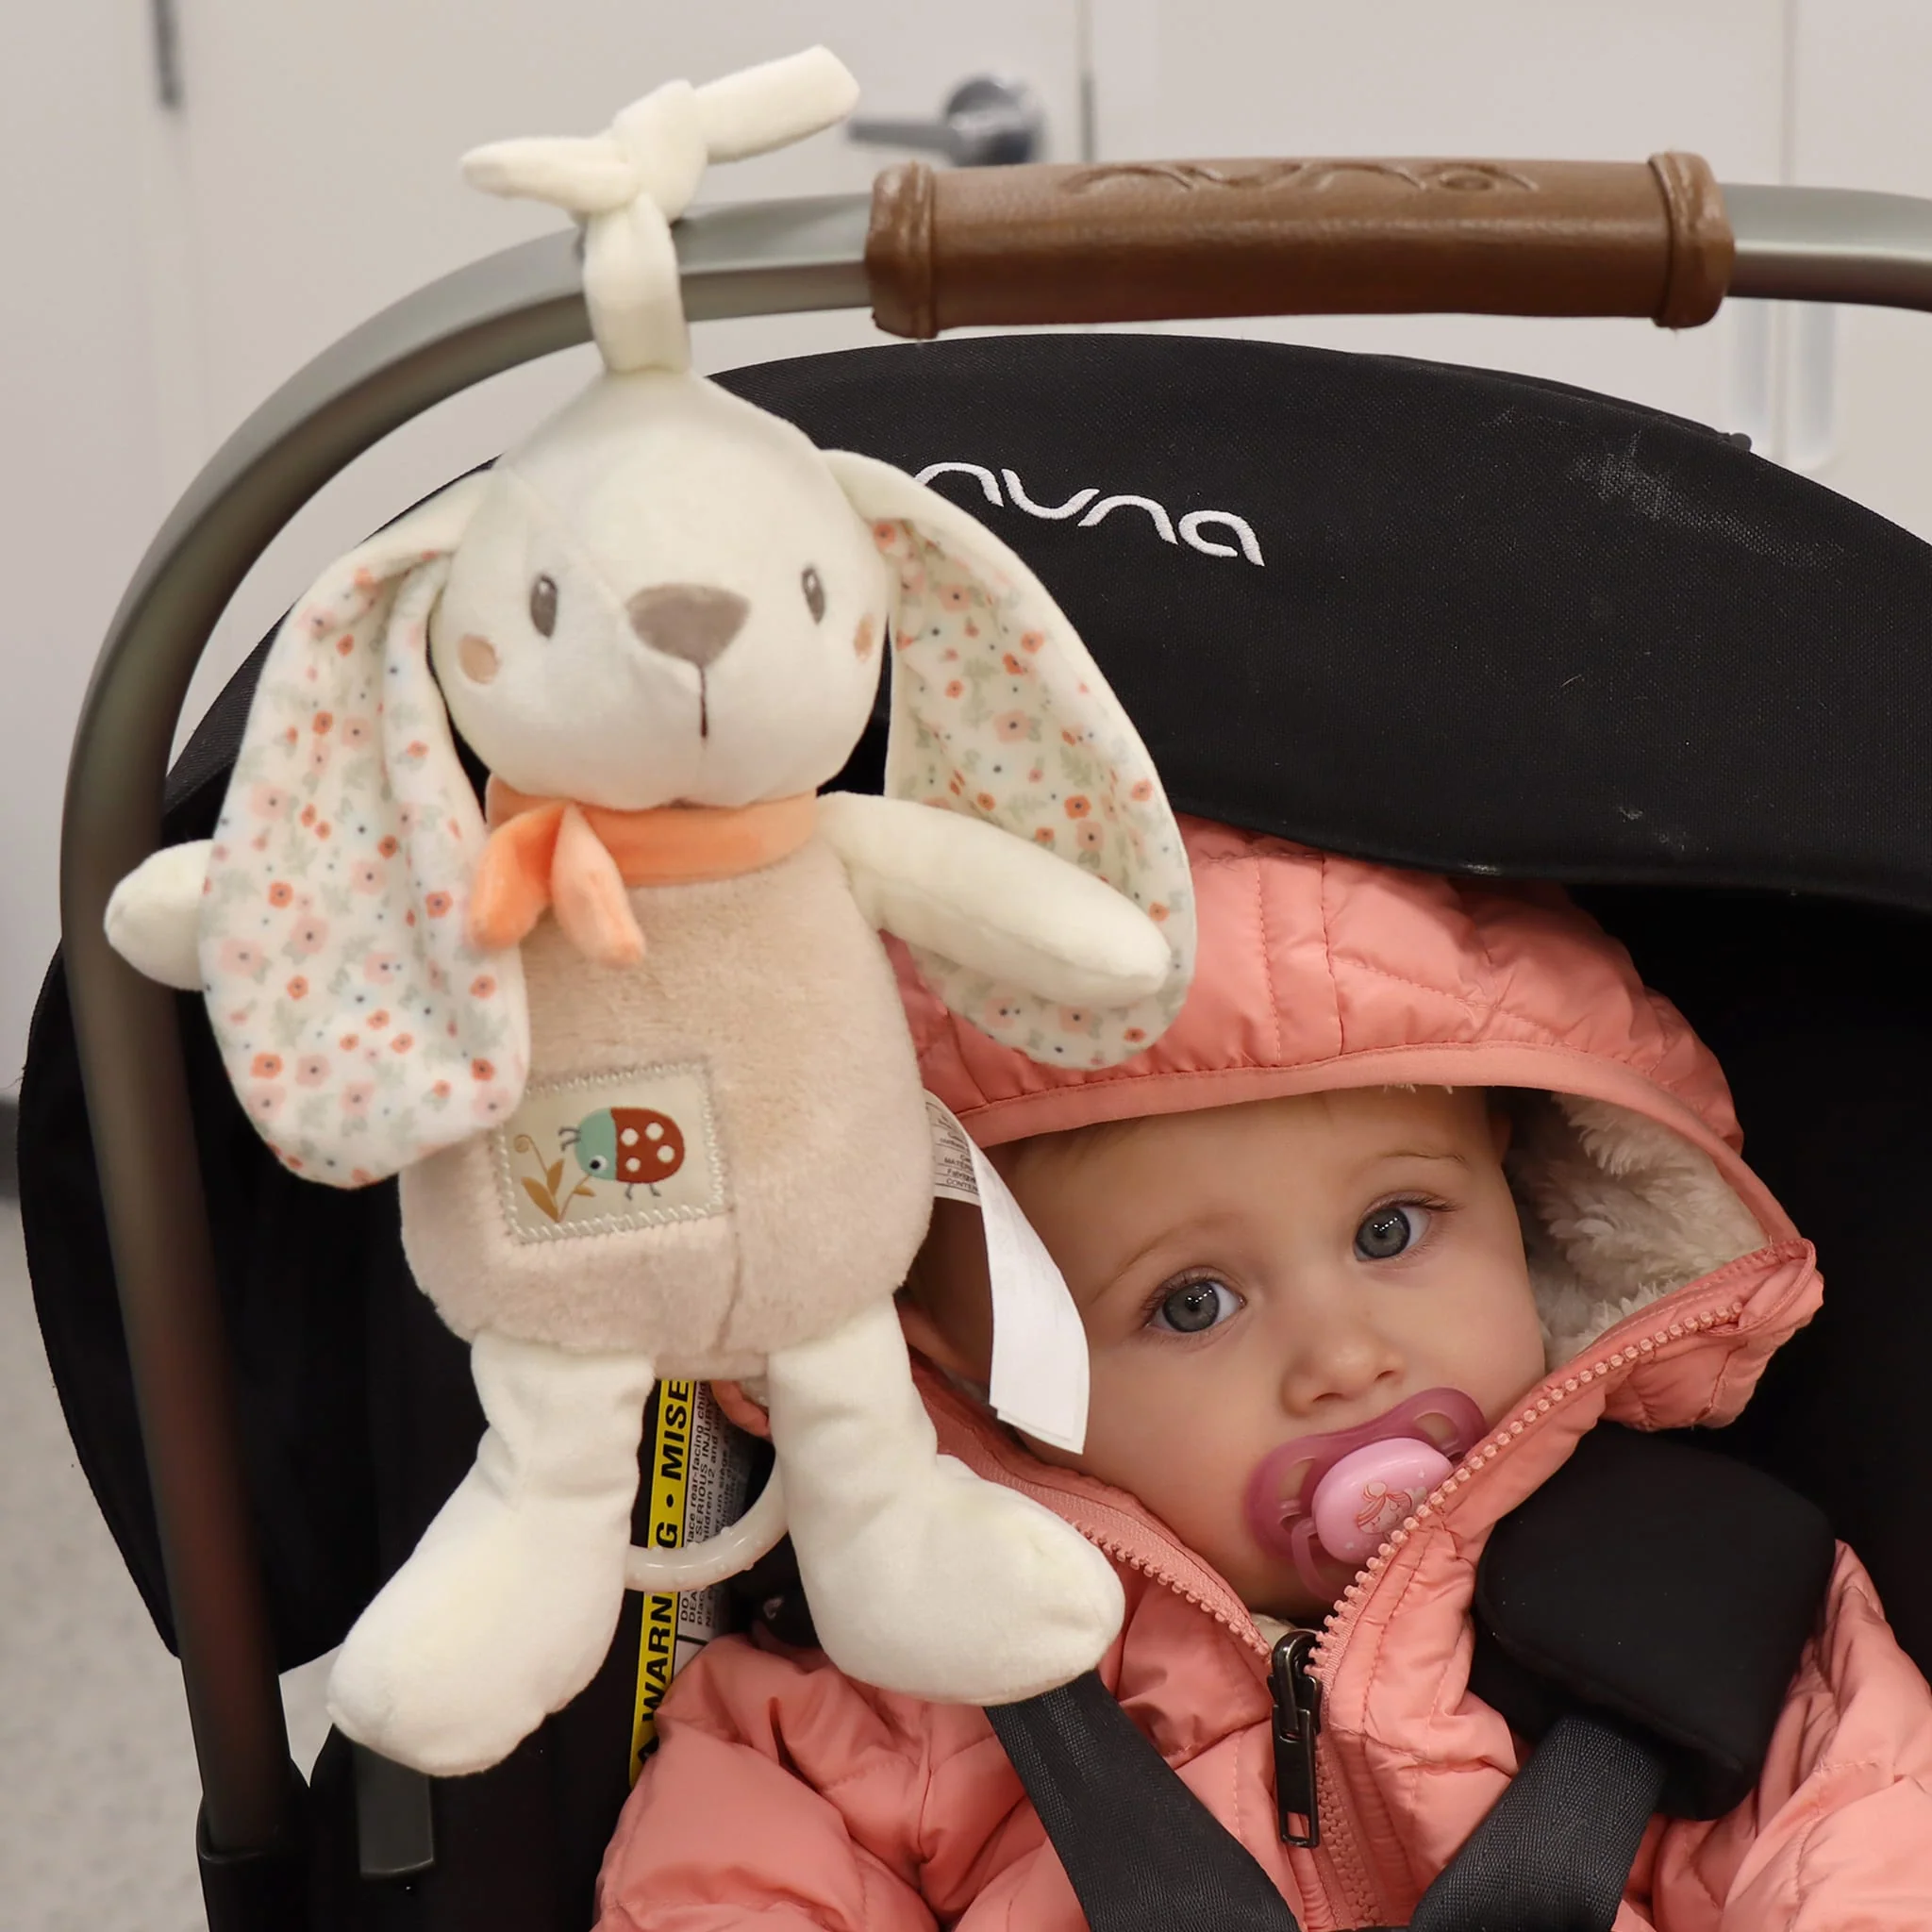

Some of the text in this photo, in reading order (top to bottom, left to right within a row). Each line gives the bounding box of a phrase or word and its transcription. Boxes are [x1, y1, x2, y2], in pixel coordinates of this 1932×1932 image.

[912, 461, 1265, 567] nuna
[661, 1380, 690, 1481] MISE
[694, 1464, 708, 1537] SERIOUS
[701, 1401, 715, 1458] INJURY
[680, 1595, 689, 1622] DO
[690, 1425, 704, 1508] rear-facing
